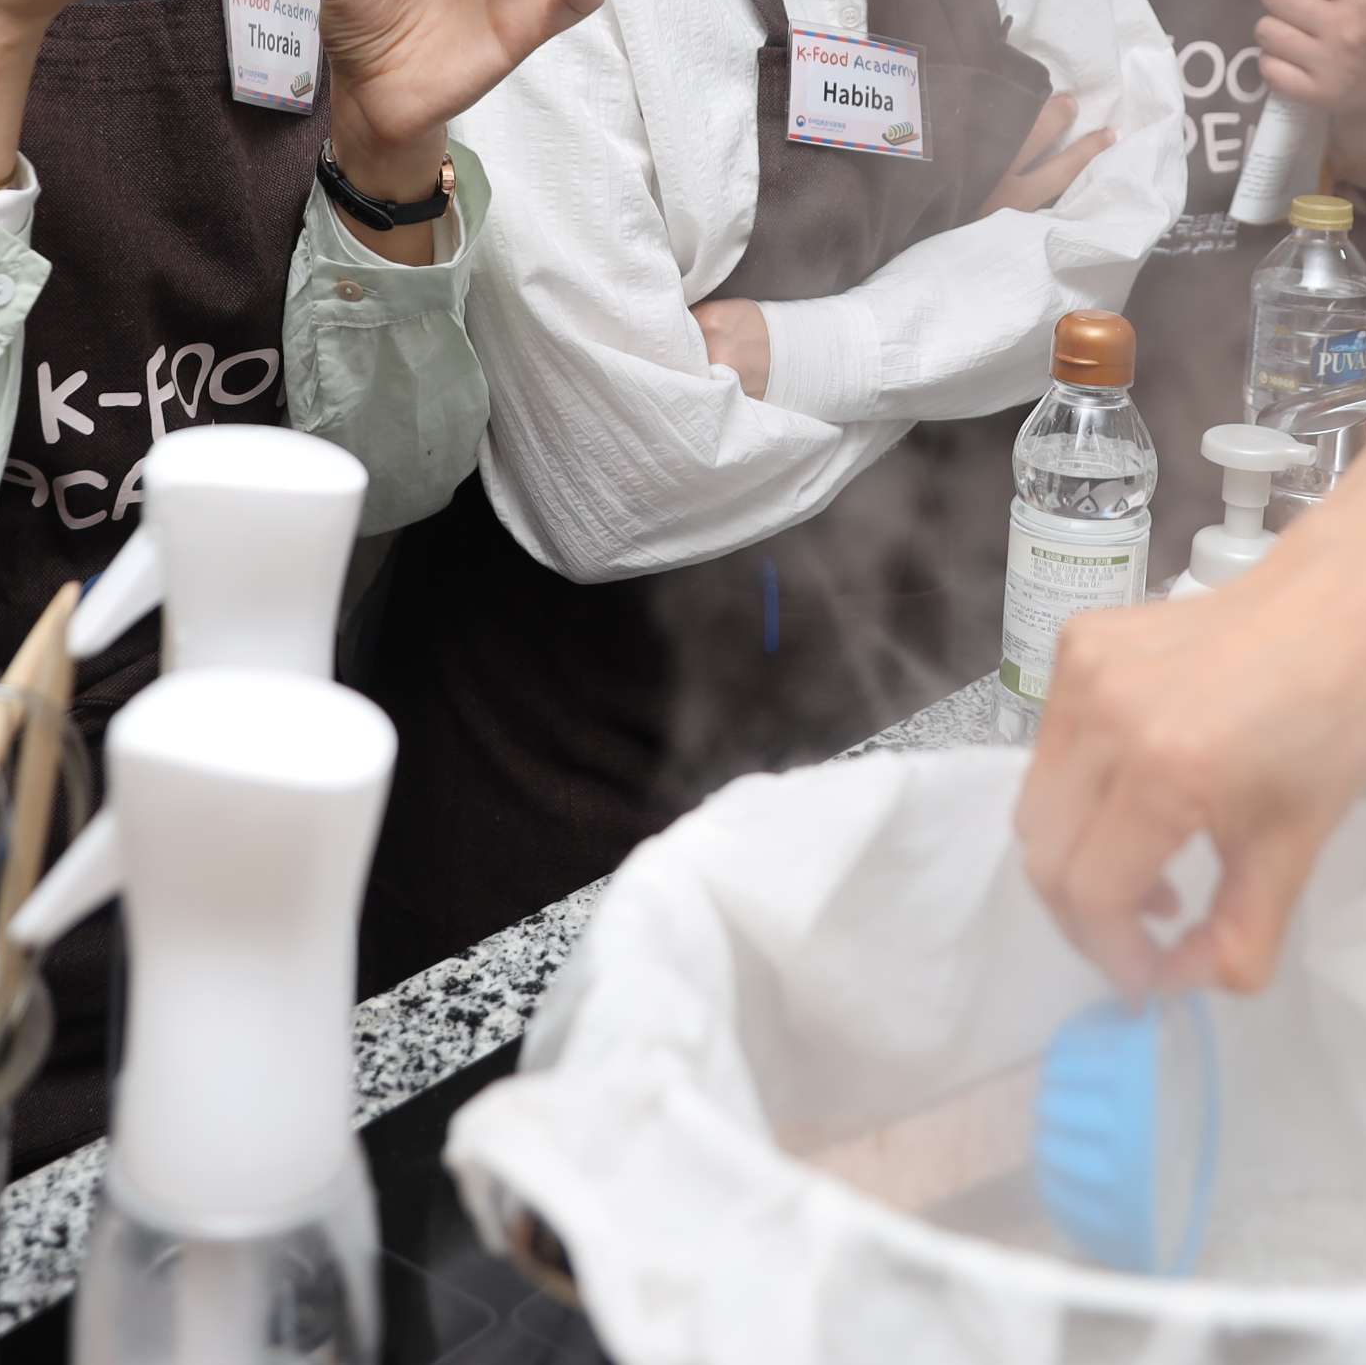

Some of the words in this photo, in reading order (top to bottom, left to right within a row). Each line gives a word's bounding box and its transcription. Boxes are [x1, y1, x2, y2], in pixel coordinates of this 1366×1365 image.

[248, 23, 301, 58] Thoraia
[796, 45, 849, 67] K-Food
[853, 55, 917, 86] Academy
[823, 81, 894, 112] Habiba
[36, 342, 284, 445] K-FOO
